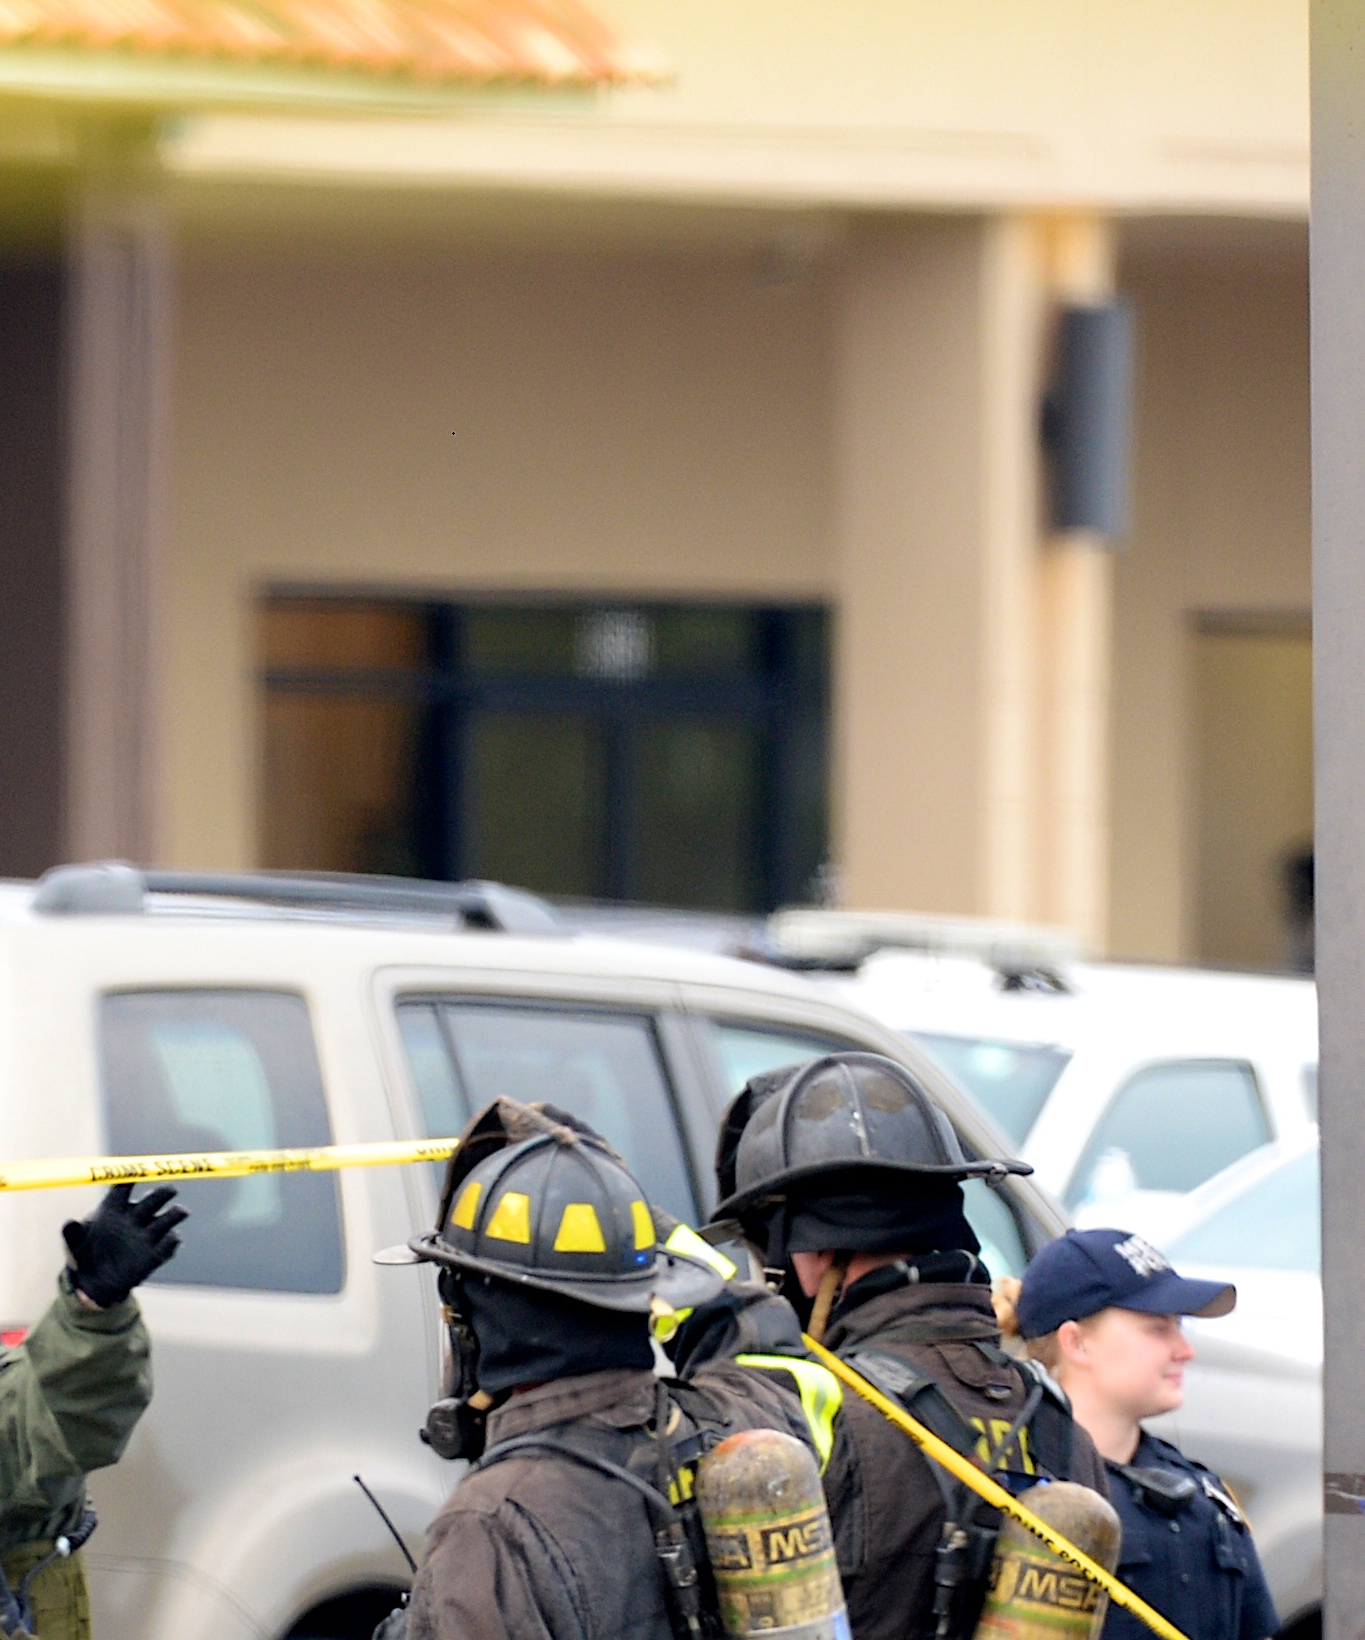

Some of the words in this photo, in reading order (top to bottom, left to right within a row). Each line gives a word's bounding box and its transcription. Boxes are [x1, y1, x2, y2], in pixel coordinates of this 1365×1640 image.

[89, 1162, 147, 1182] CRIME
[156, 1157, 215, 1176] SCENE
[769, 1521, 821, 1561] MS
